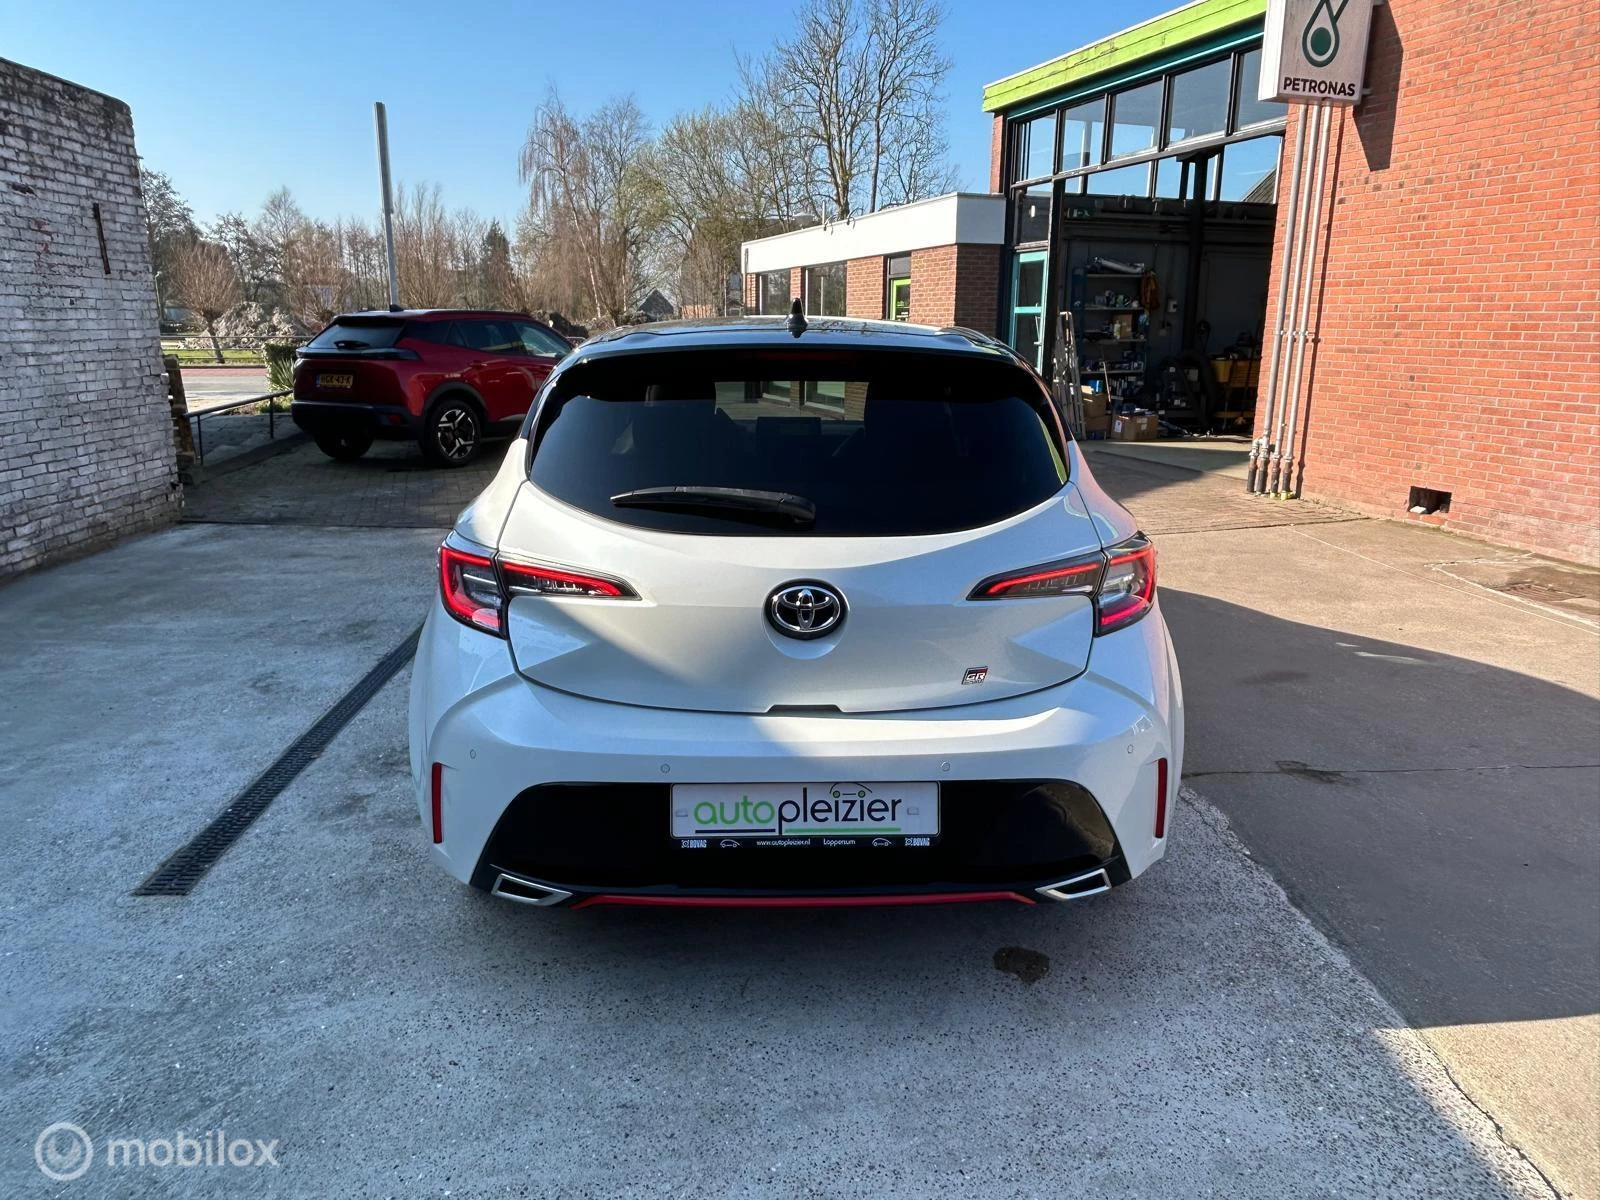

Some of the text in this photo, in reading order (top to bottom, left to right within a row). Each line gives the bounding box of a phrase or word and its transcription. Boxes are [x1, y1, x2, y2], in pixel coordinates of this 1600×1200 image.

[1283, 77, 1356, 97] PETRONAS
[694, 787, 902, 835] autopleizier
[756, 838, 811, 847] www.autopleizier.nl
